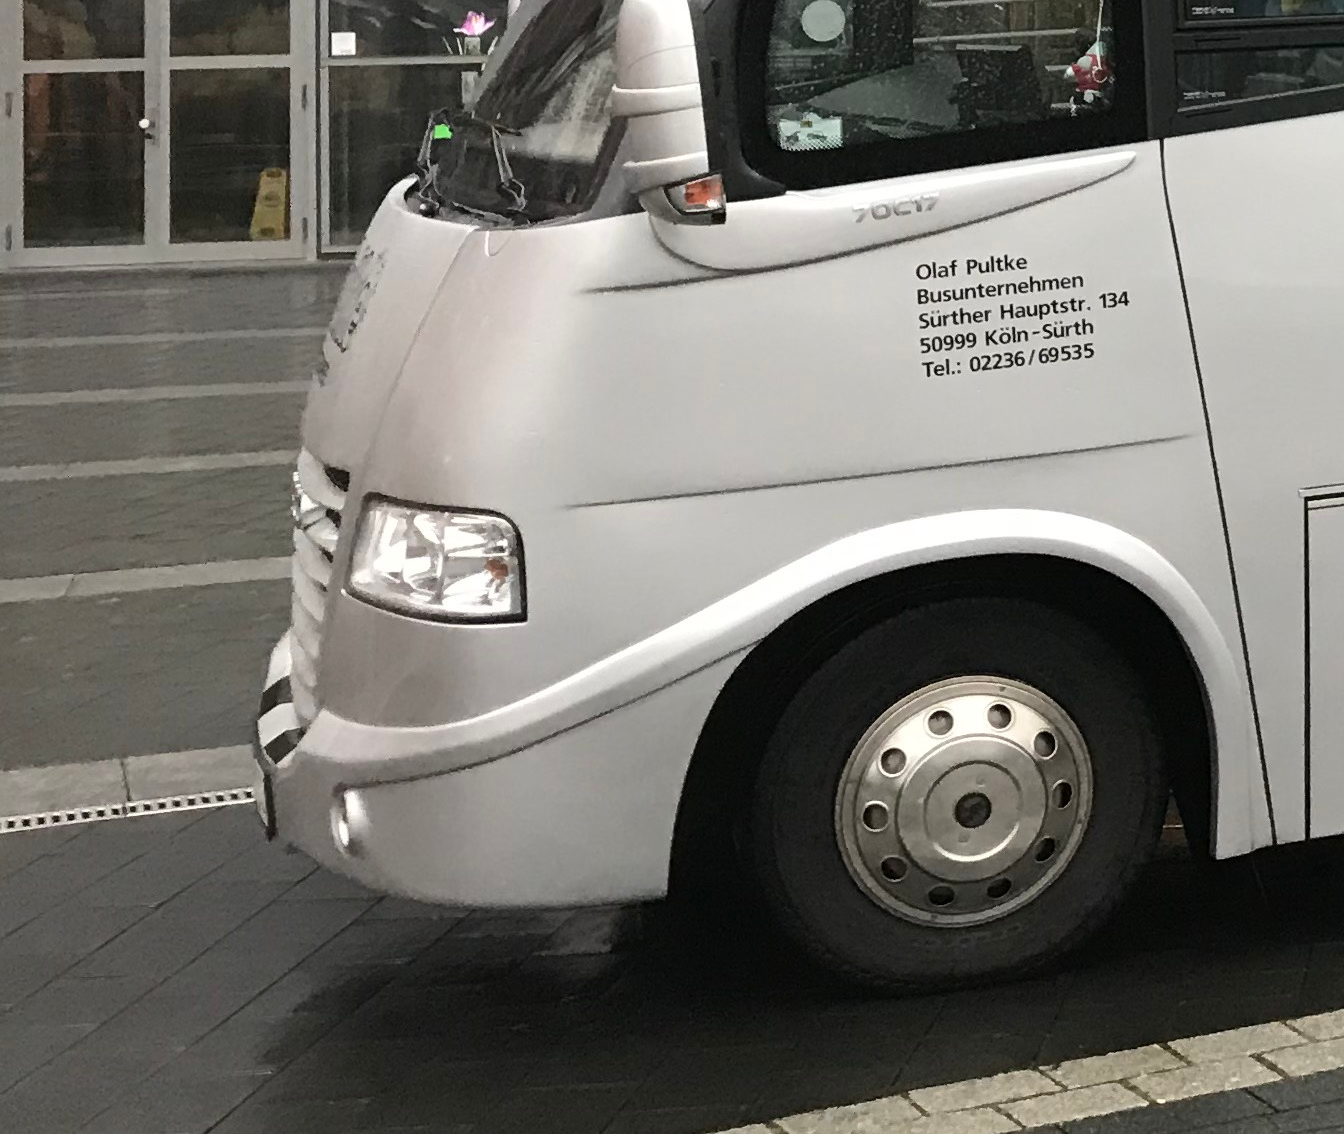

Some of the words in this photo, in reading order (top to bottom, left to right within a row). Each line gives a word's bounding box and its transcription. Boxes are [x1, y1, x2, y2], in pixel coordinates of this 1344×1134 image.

[851, 193, 939, 223] 70C17
[915, 259, 958, 280] Olaf
[966, 254, 1028, 276] Pultke
[916, 274, 1084, 305] Busunternehmen
[918, 308, 992, 330] Sürther
[999, 297, 1091, 321] Hauptstr.
[1098, 290, 1130, 309] 134
[919, 332, 977, 354] 50999
[921, 359, 962, 378] Tel.:
[969, 342, 1095, 373] 02236/69535
